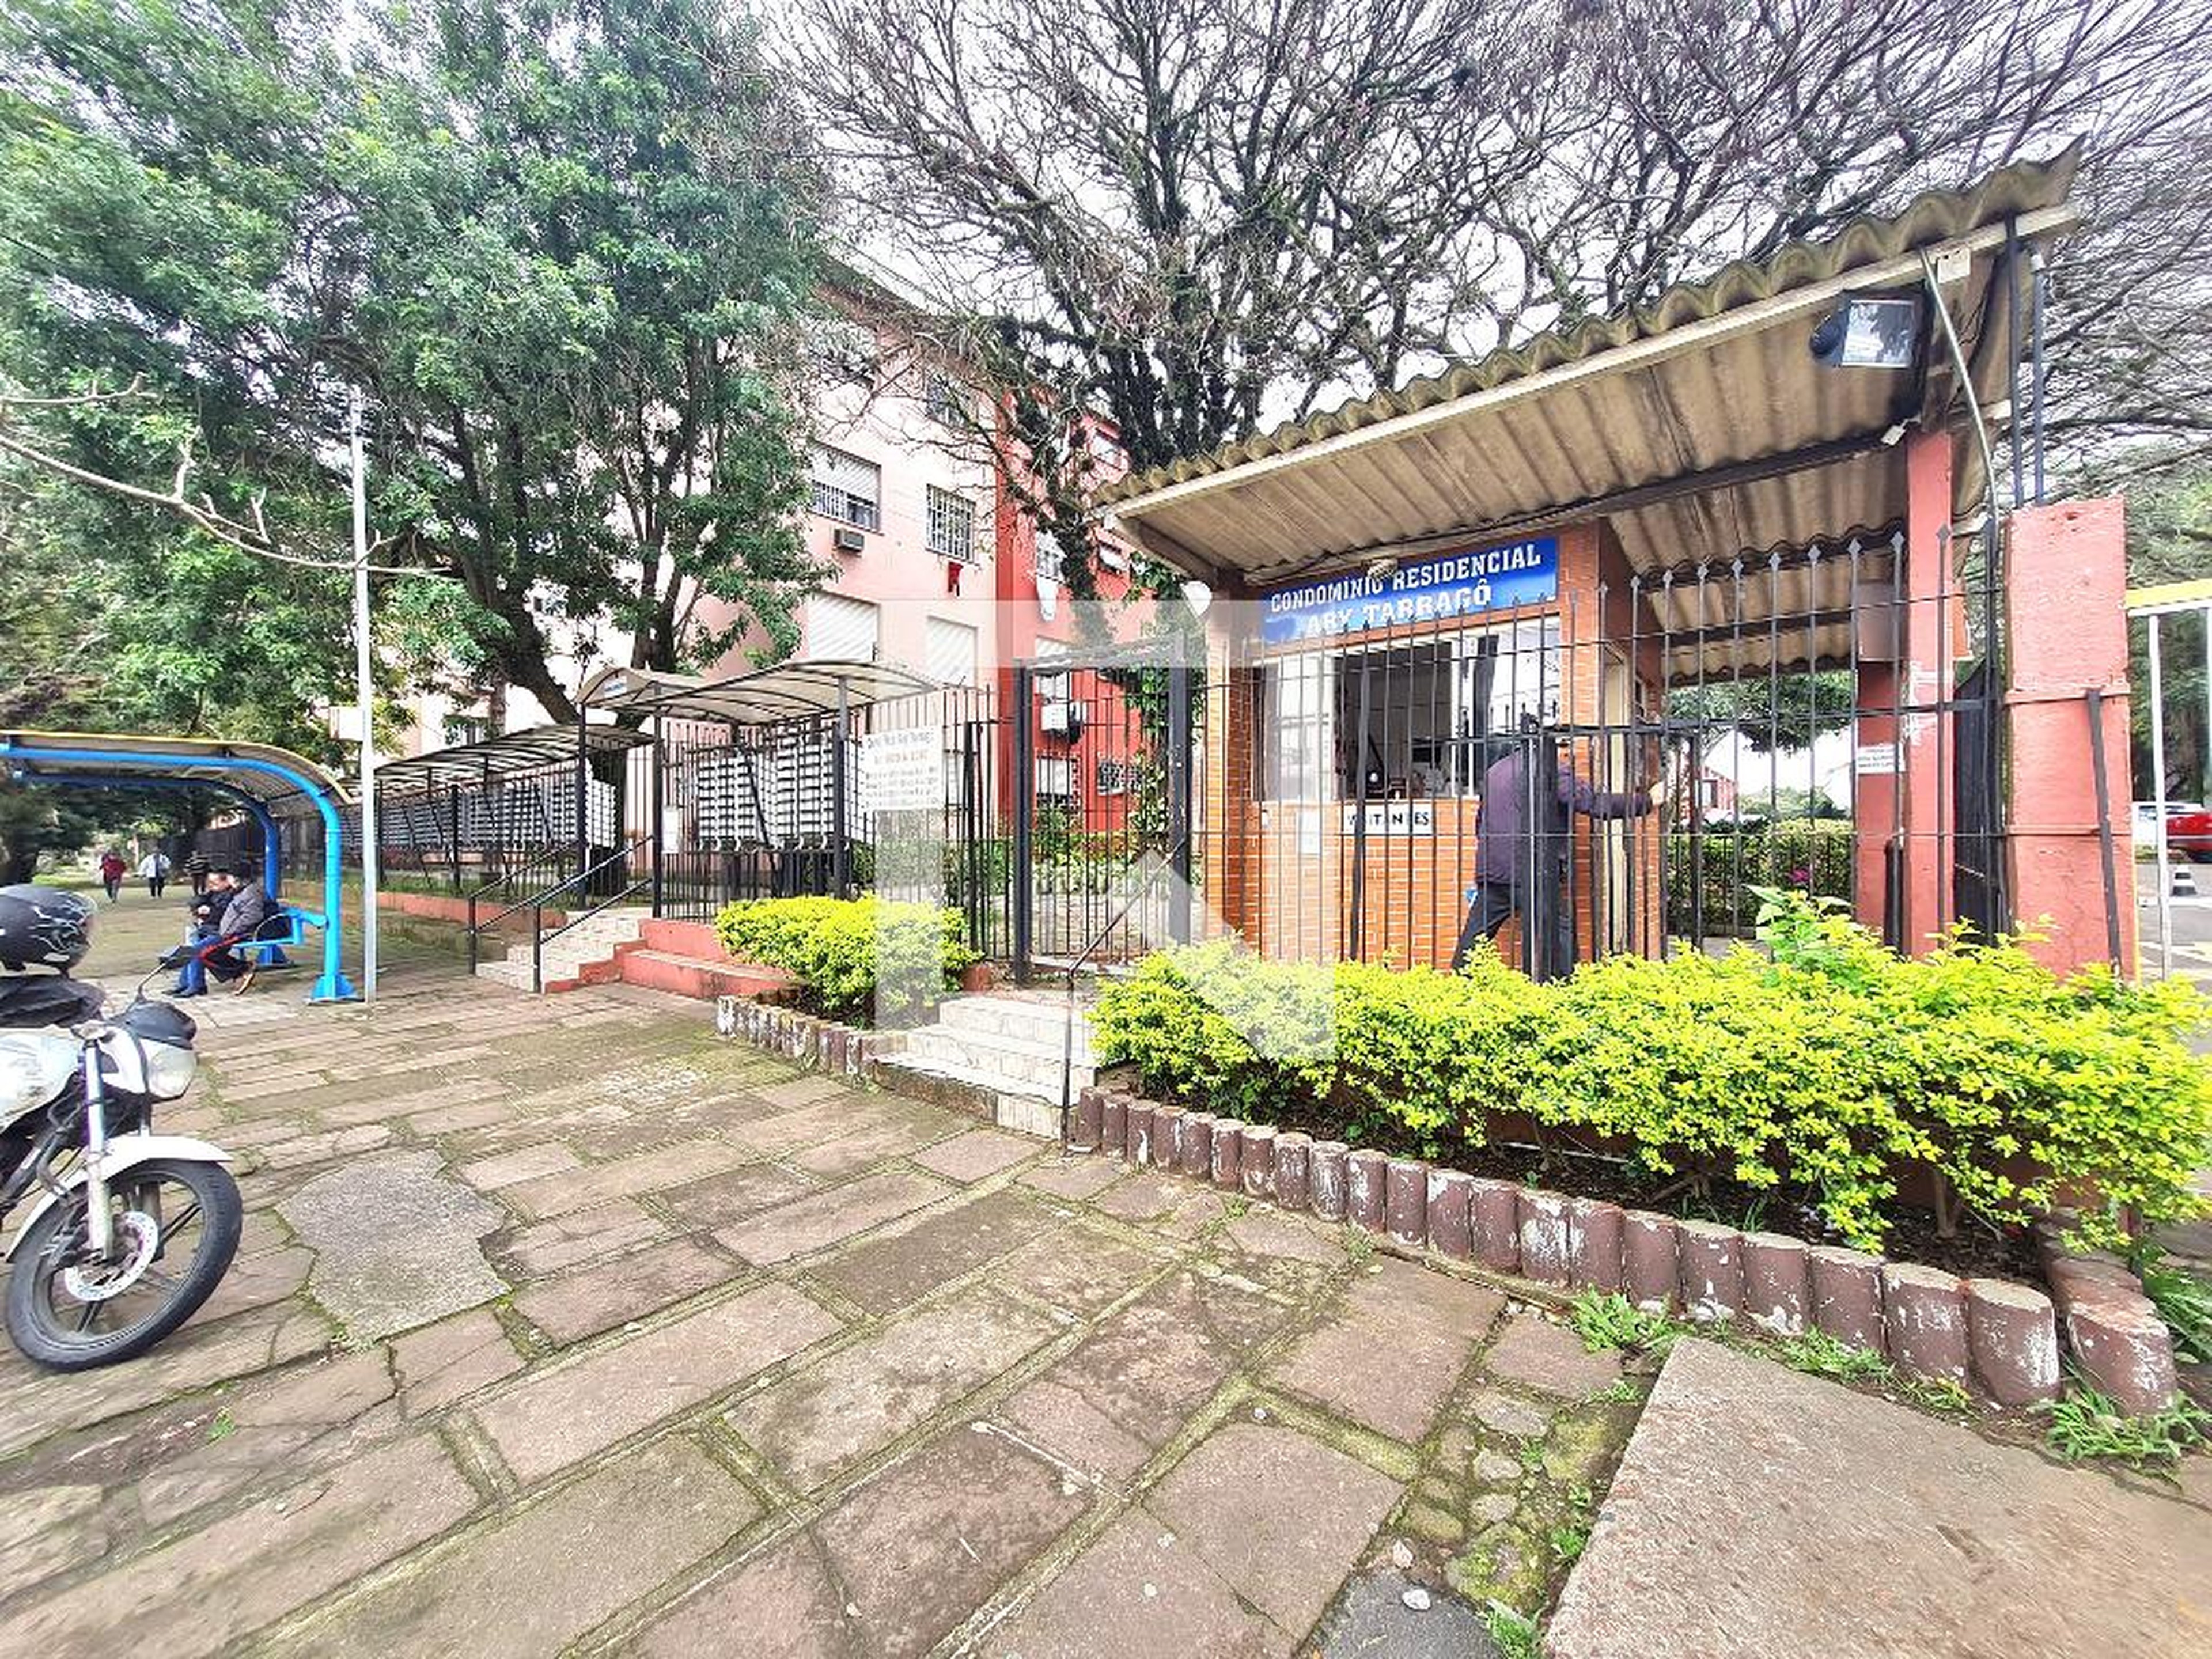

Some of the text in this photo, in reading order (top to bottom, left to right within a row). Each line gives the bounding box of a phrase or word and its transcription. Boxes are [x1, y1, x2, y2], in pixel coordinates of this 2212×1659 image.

[1392, 543, 1541, 591] RESIDENCIAL
[1306, 578, 1492, 634] ARY TARRAGÔ
